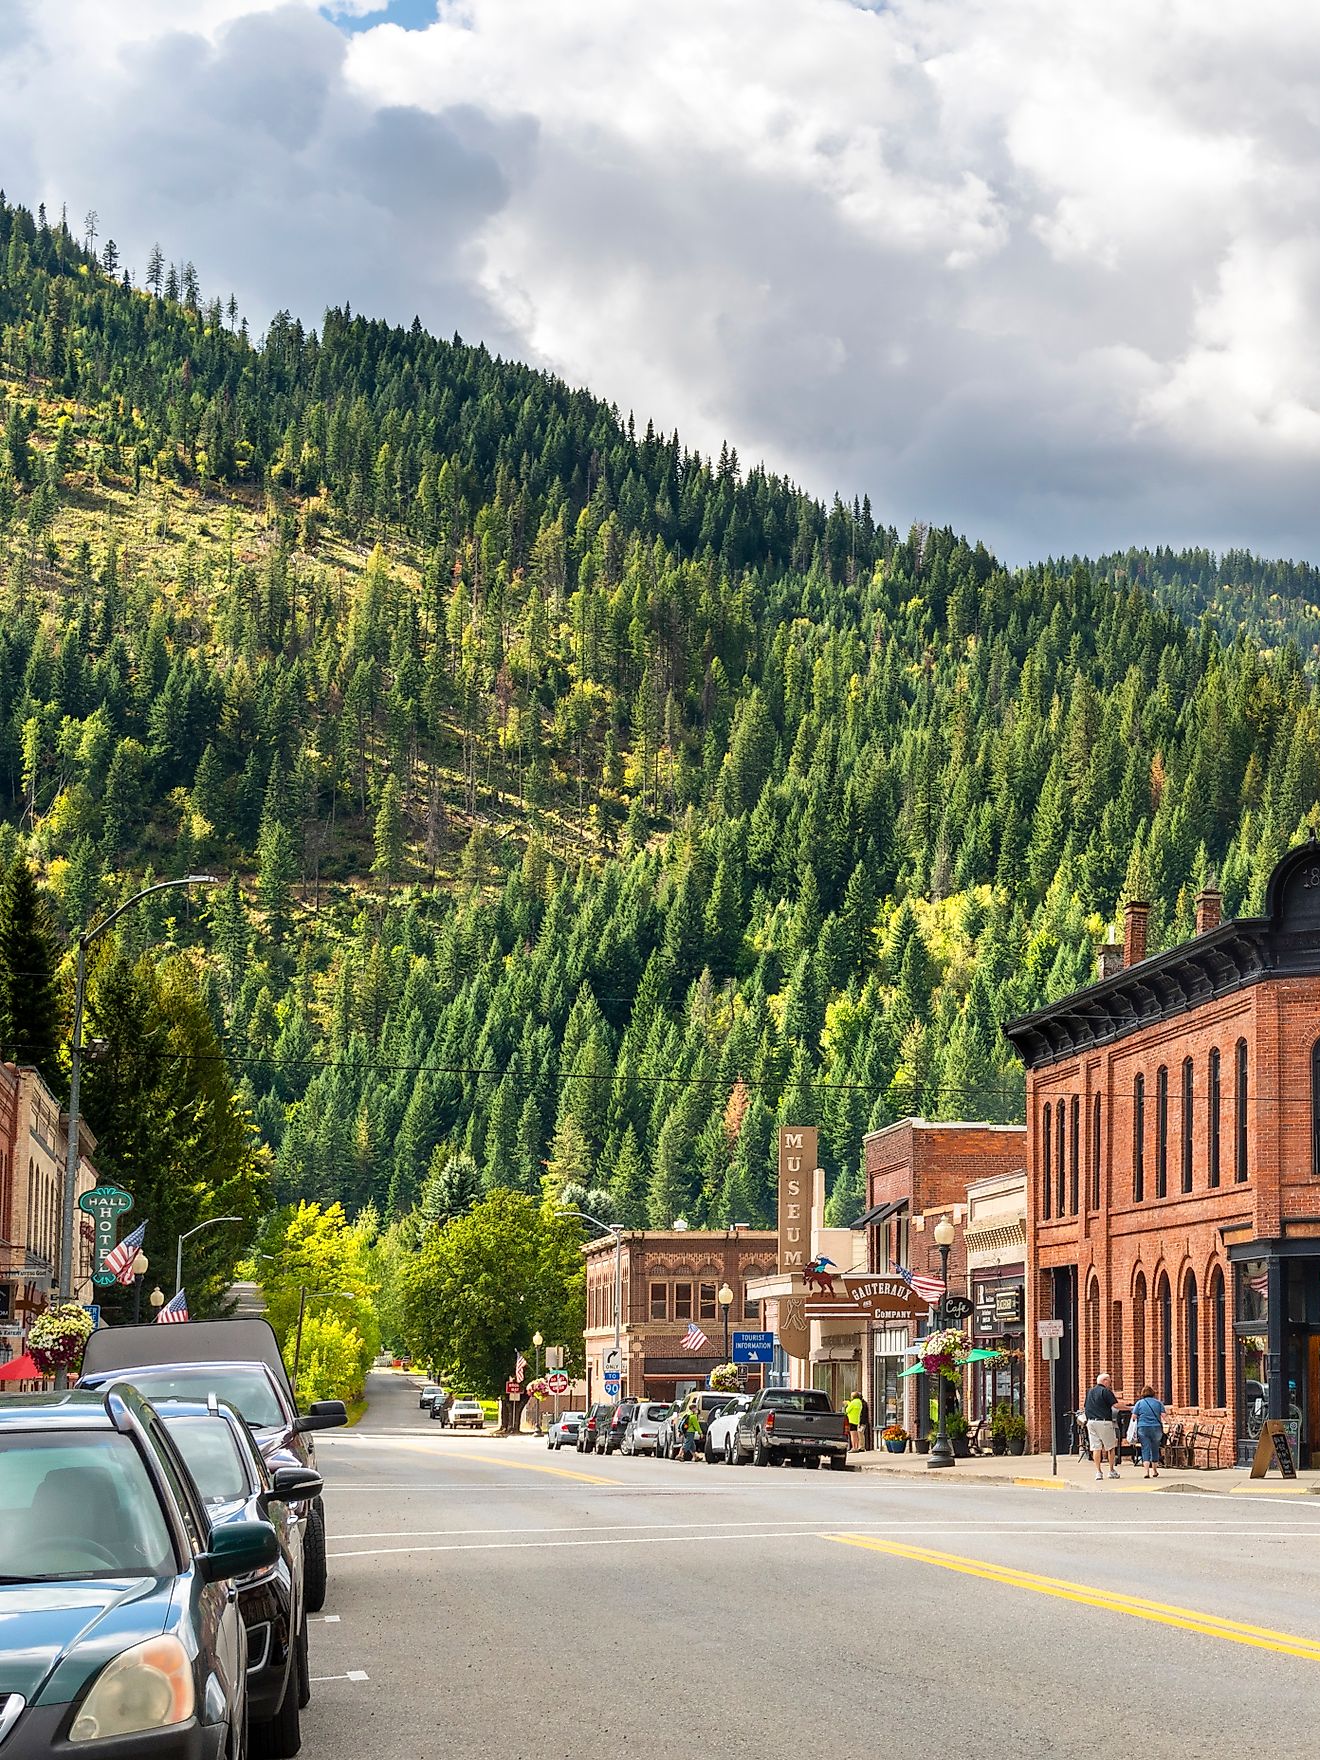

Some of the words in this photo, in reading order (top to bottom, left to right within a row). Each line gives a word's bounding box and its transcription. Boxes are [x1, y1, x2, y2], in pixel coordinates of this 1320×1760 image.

[89, 1198, 126, 1206] HALL
[784, 1133, 803, 1266] MUSEUM
[99, 1207, 112, 1273] HOTEL
[851, 1282, 913, 1302] GAUTERAUX
[945, 1299, 969, 1318] Cafe
[605, 1384, 619, 1393] 90
